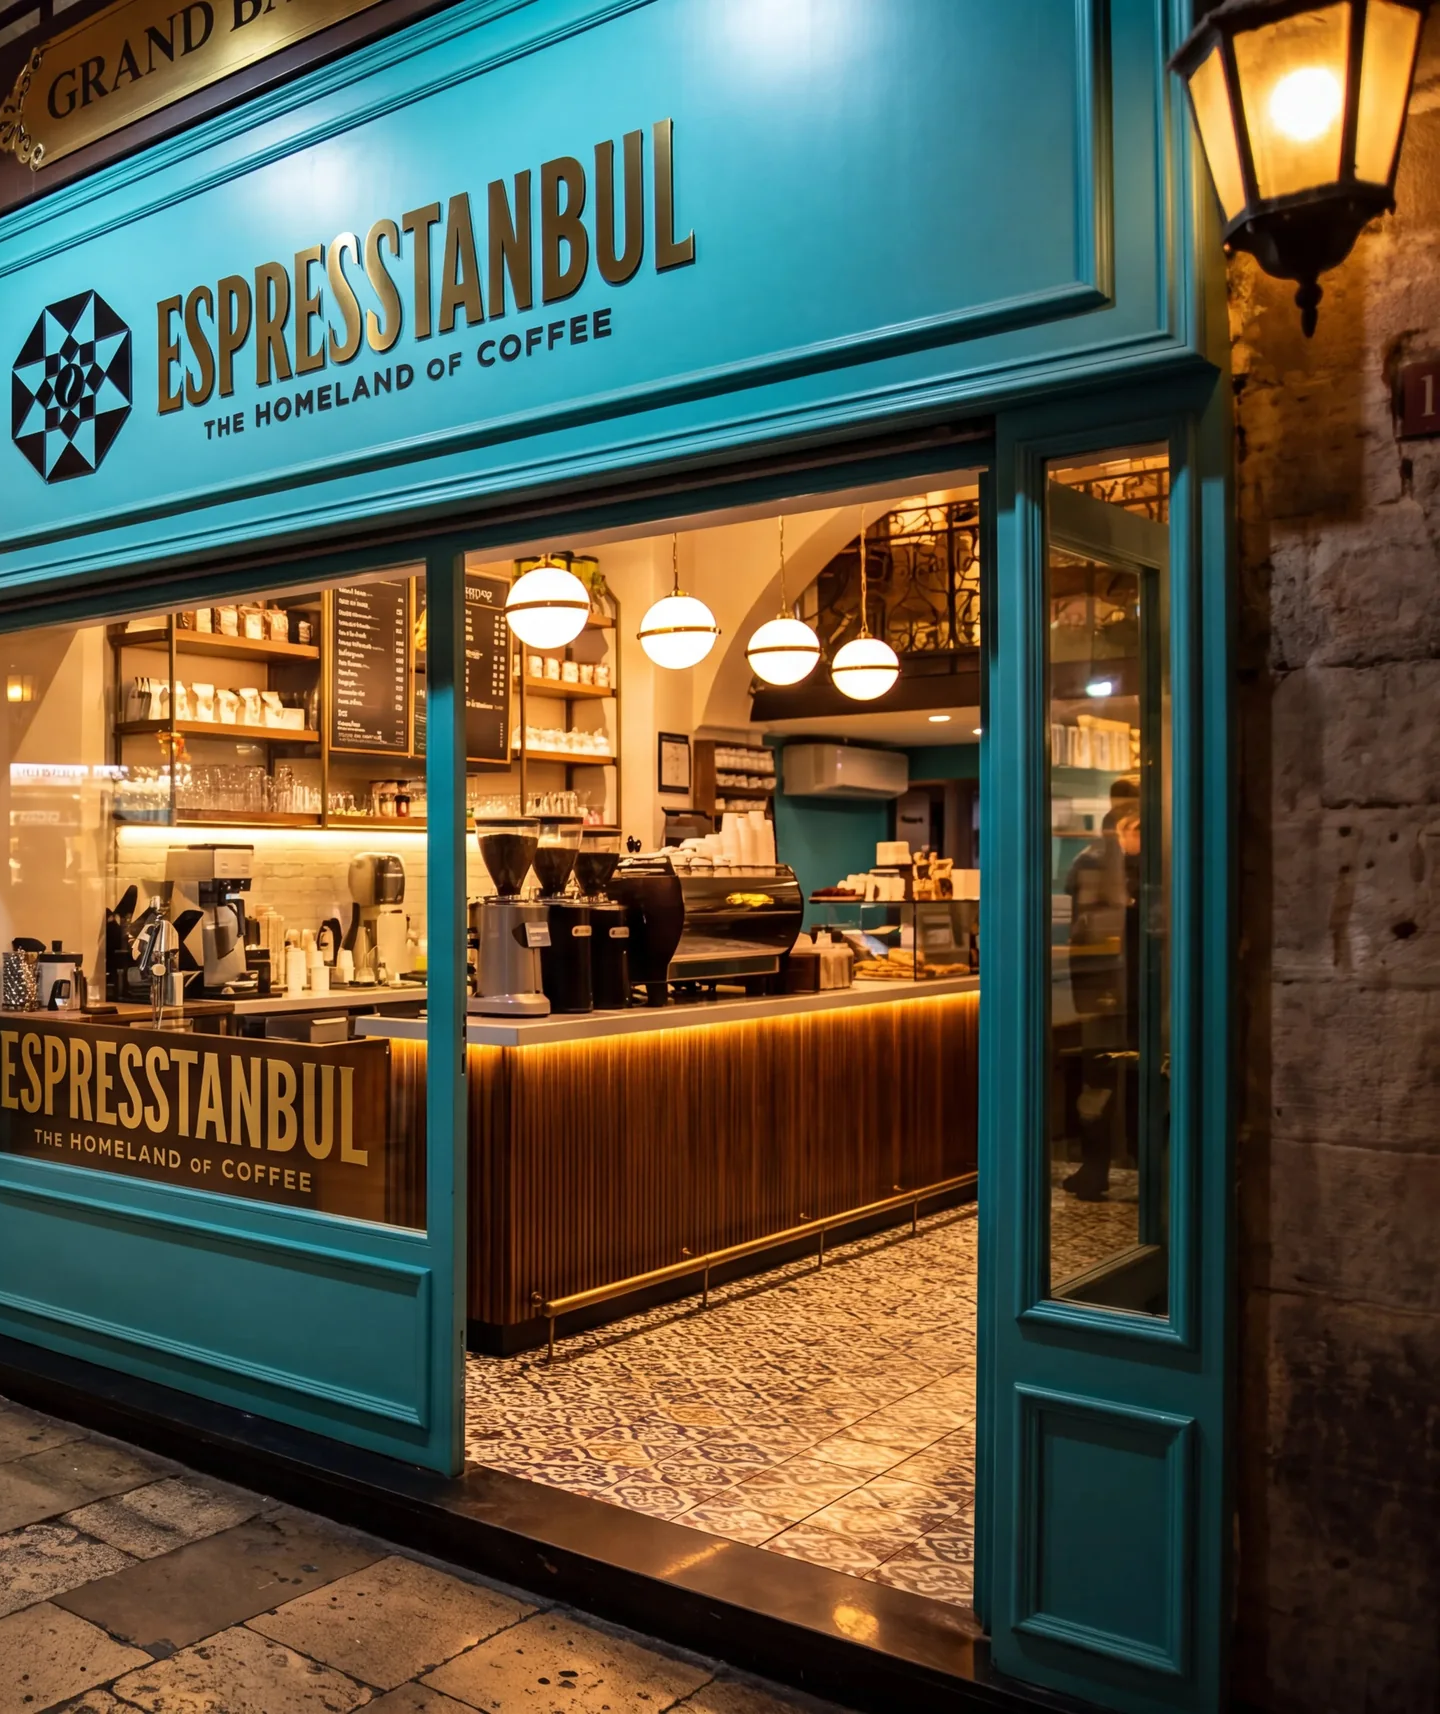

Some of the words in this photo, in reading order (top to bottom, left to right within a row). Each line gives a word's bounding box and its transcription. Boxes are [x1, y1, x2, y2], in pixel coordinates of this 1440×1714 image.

[47, 0, 215, 120] GRAND
[156, 117, 695, 416] ESPRESSTANBUL
[203, 411, 245, 440] THE
[254, 364, 415, 430] HOMELAND
[427, 354, 463, 381] OF
[476, 307, 613, 368] COFFEE
[0, 1030, 369, 1167] ESPRESSTANBUL
[34, 1128, 63, 1148] THE
[69, 1133, 182, 1170] HOMELAND
[189, 1156, 212, 1175] OF
[221, 1158, 312, 1194] COFFEE
